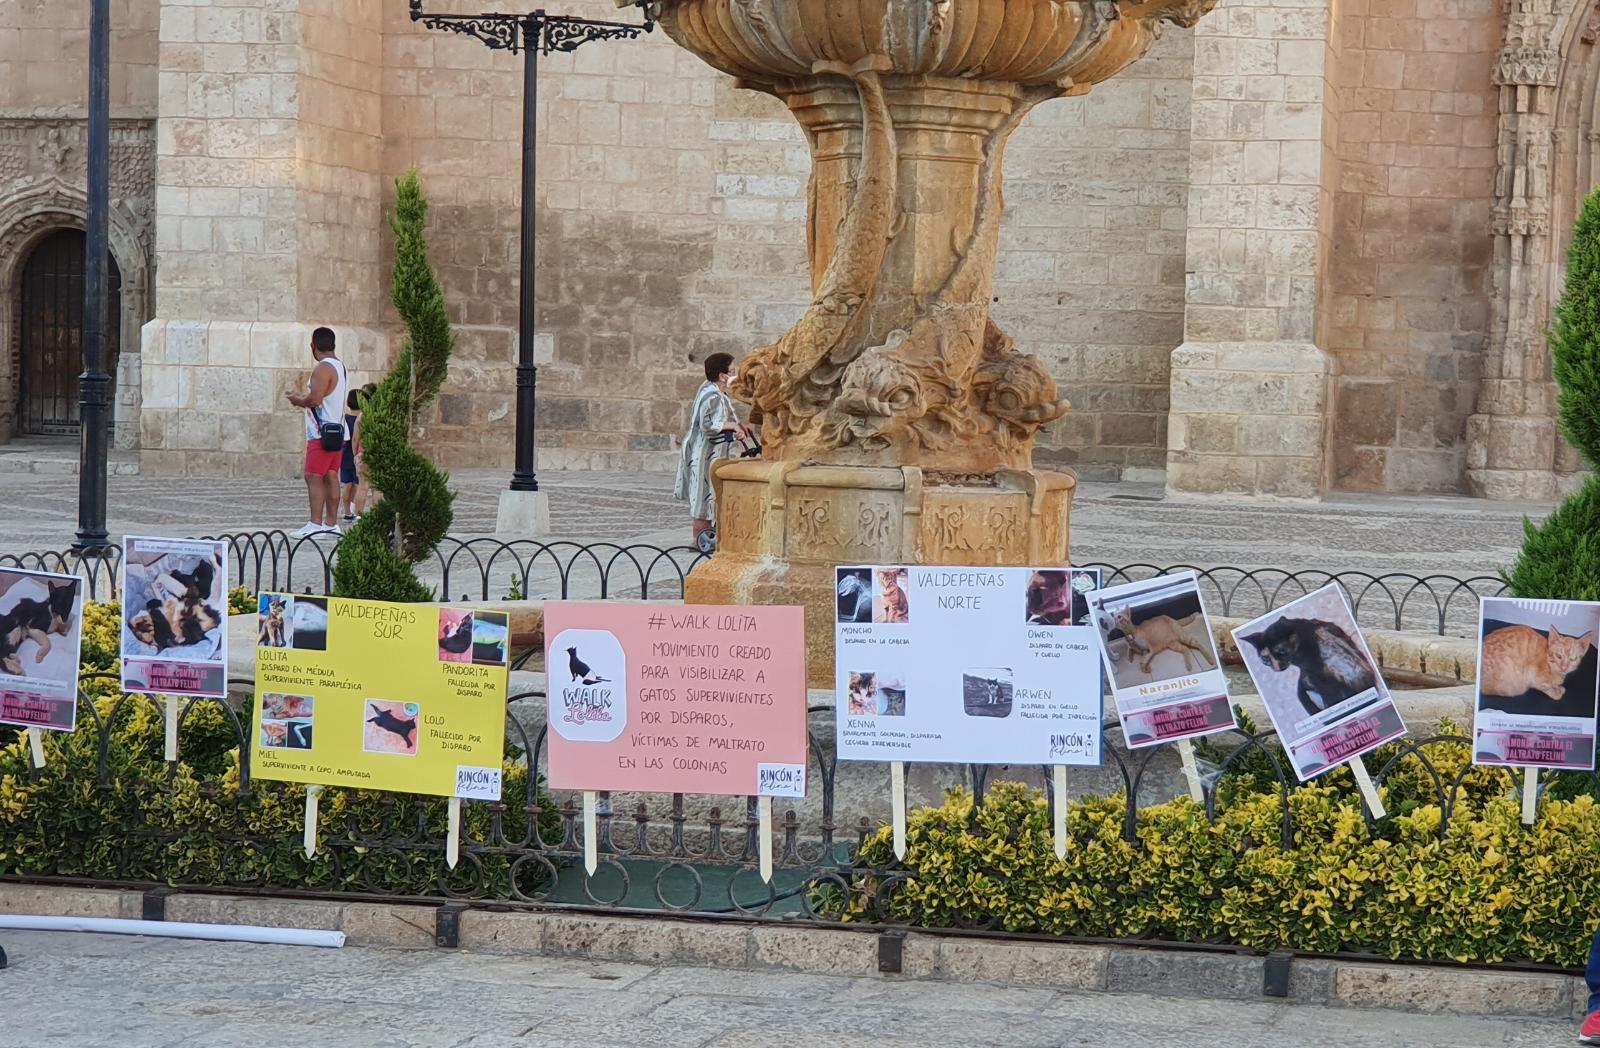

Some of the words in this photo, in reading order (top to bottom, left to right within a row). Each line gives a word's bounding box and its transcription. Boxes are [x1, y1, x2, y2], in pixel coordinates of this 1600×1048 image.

[918, 572, 1005, 588] VALDEPEÑAS
[937, 596, 982, 610] NORTE
[334, 603, 416, 623] VALDEPEÑAS
[373, 622, 404, 640] SUR
[717, 615, 757, 632] LOLITA
[1028, 629, 1054, 639] OWEN
[258, 649, 288, 661] LOLITA
[652, 642, 719, 659] MOVIMIENTO
[729, 646, 771, 661] CREADO
[261, 663, 290, 673] DISPARO
[306, 664, 335, 677] MÉDULA
[442, 663, 489, 677] PANDORITA
[641, 665, 670, 680] PARA
[679, 665, 745, 683] VISIBILIZAR
[756, 671, 765, 684] A
[263, 673, 315, 686] SUPERVIVIENTE
[319, 678, 362, 690] PARAPLÉJICA
[447, 678, 479, 688] FALLECIDA
[484, 682, 496, 691] POR
[1139, 677, 1199, 696] Naranjito
[456, 689, 483, 698] DISPARO
[563, 688, 612, 708] WALK
[639, 688, 676, 702] GATOS
[686, 688, 774, 706] SUPERVIVIENTES
[1015, 689, 1052, 700] ARWEN
[424, 715, 445, 725] LOLO
[563, 702, 612, 725] Lolita
[640, 711, 662, 724] POR
[671, 710, 734, 728] DISPAROS,
[847, 719, 876, 729] XENNA
[430, 729, 464, 741] FALLECIDO
[468, 734, 482, 743] POR
[631, 732, 679, 748] VÍCTIMAS
[686, 736, 701, 748] DE
[708, 737, 765, 752] MALTRATO
[1050, 732, 1083, 748] RINCÓN
[258, 750, 278, 759] MIEL
[441, 741, 472, 752] DISPARO
[262, 761, 306, 771] SUPERVIVIENTE
[309, 764, 314, 772] A
[336, 768, 371, 779] AMPUTADA
[618, 756, 636, 769] EN
[644, 757, 664, 769] LAS
[673, 757, 727, 774] COLONIAS
[458, 769, 489, 784] RINCÓN
[760, 767, 792, 782] RINCÓN
